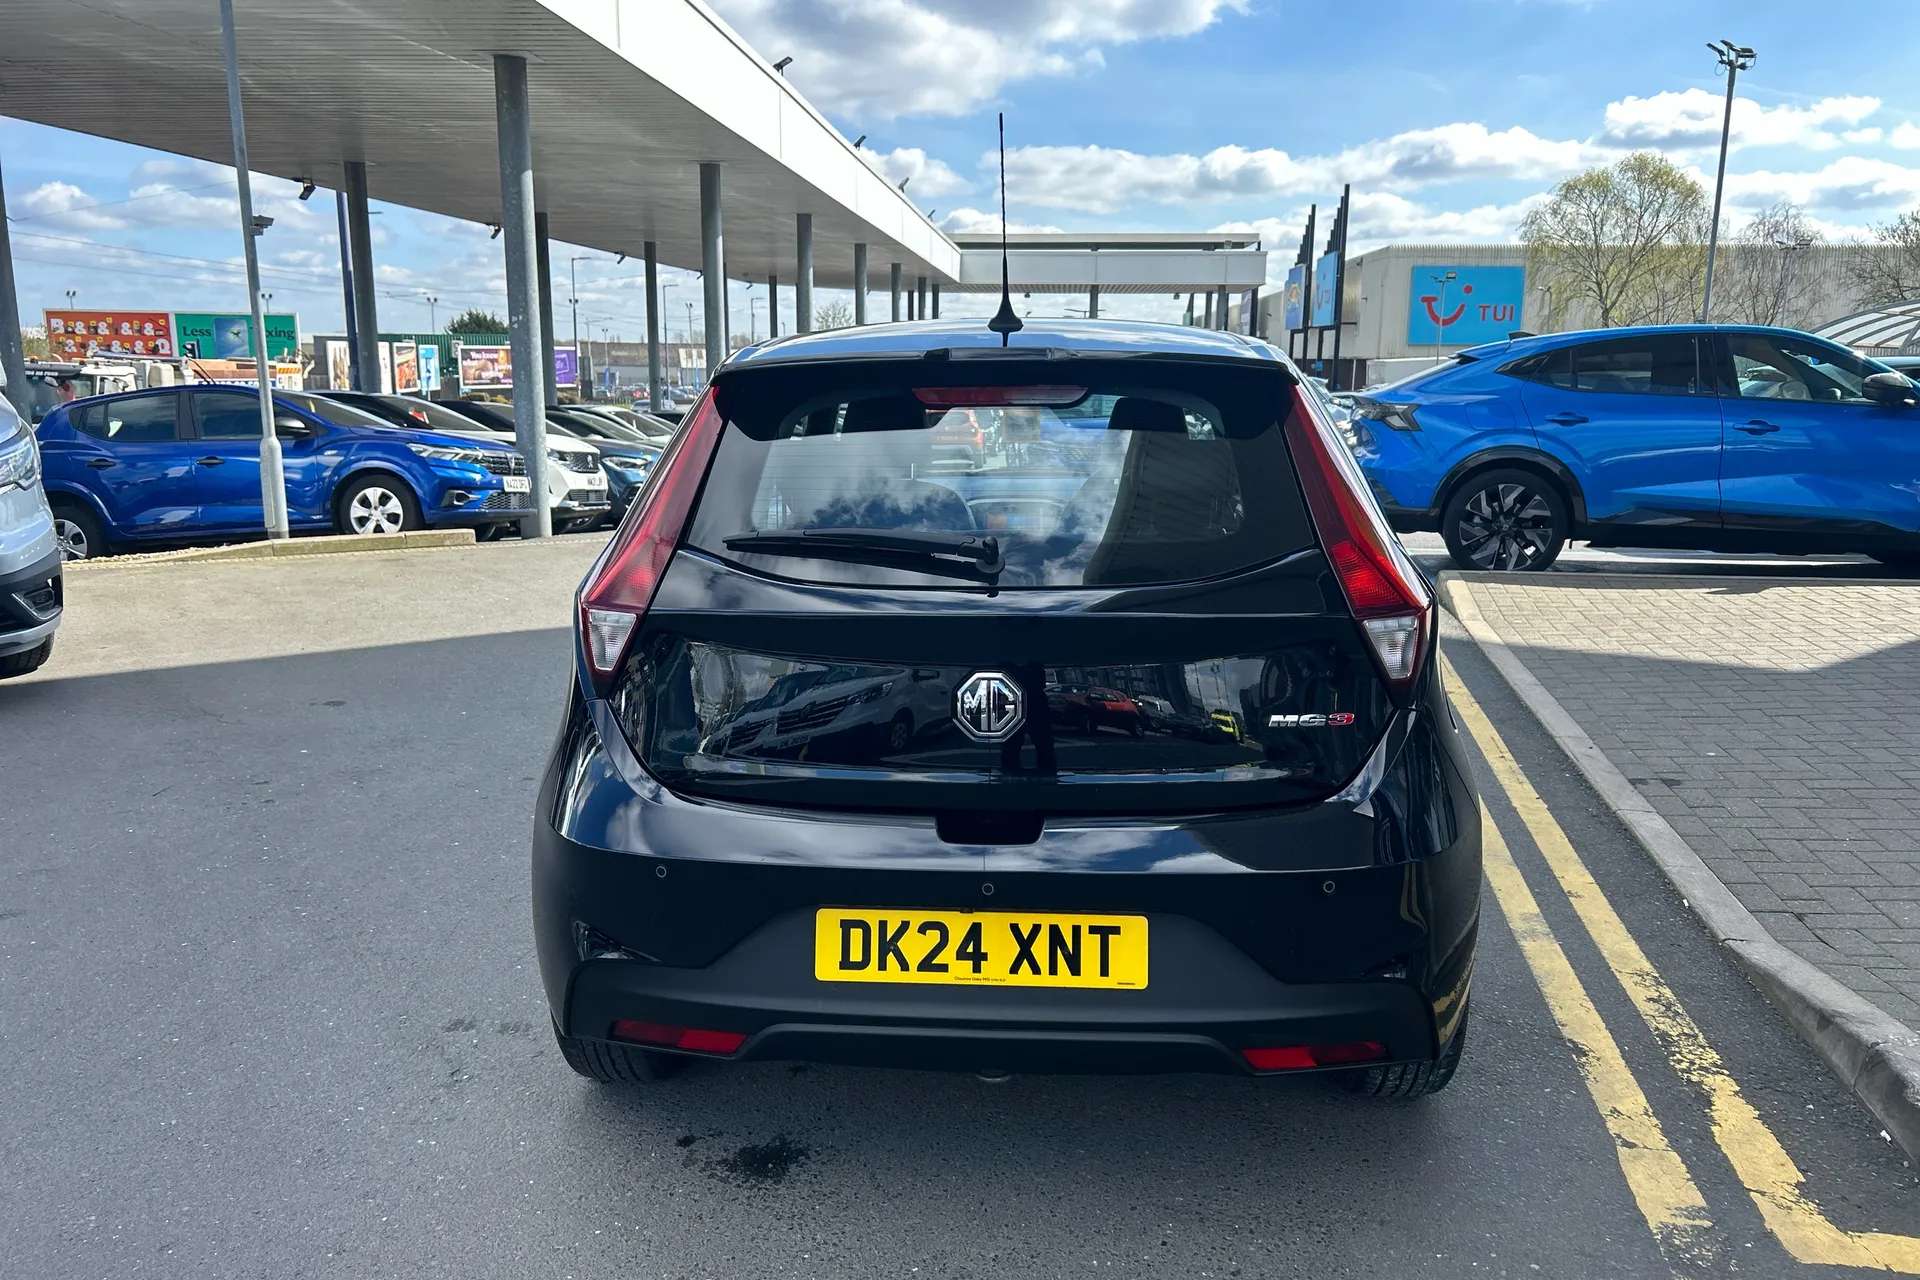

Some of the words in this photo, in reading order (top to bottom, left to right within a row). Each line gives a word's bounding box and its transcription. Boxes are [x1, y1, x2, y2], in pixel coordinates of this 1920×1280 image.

[1479, 304, 1514, 321] TUI
[182, 326, 211, 336] Less
[963, 679, 1015, 731] MG
[1269, 712, 1355, 727] MG3
[839, 918, 988, 974] DK24
[1009, 922, 1121, 977] XNT
